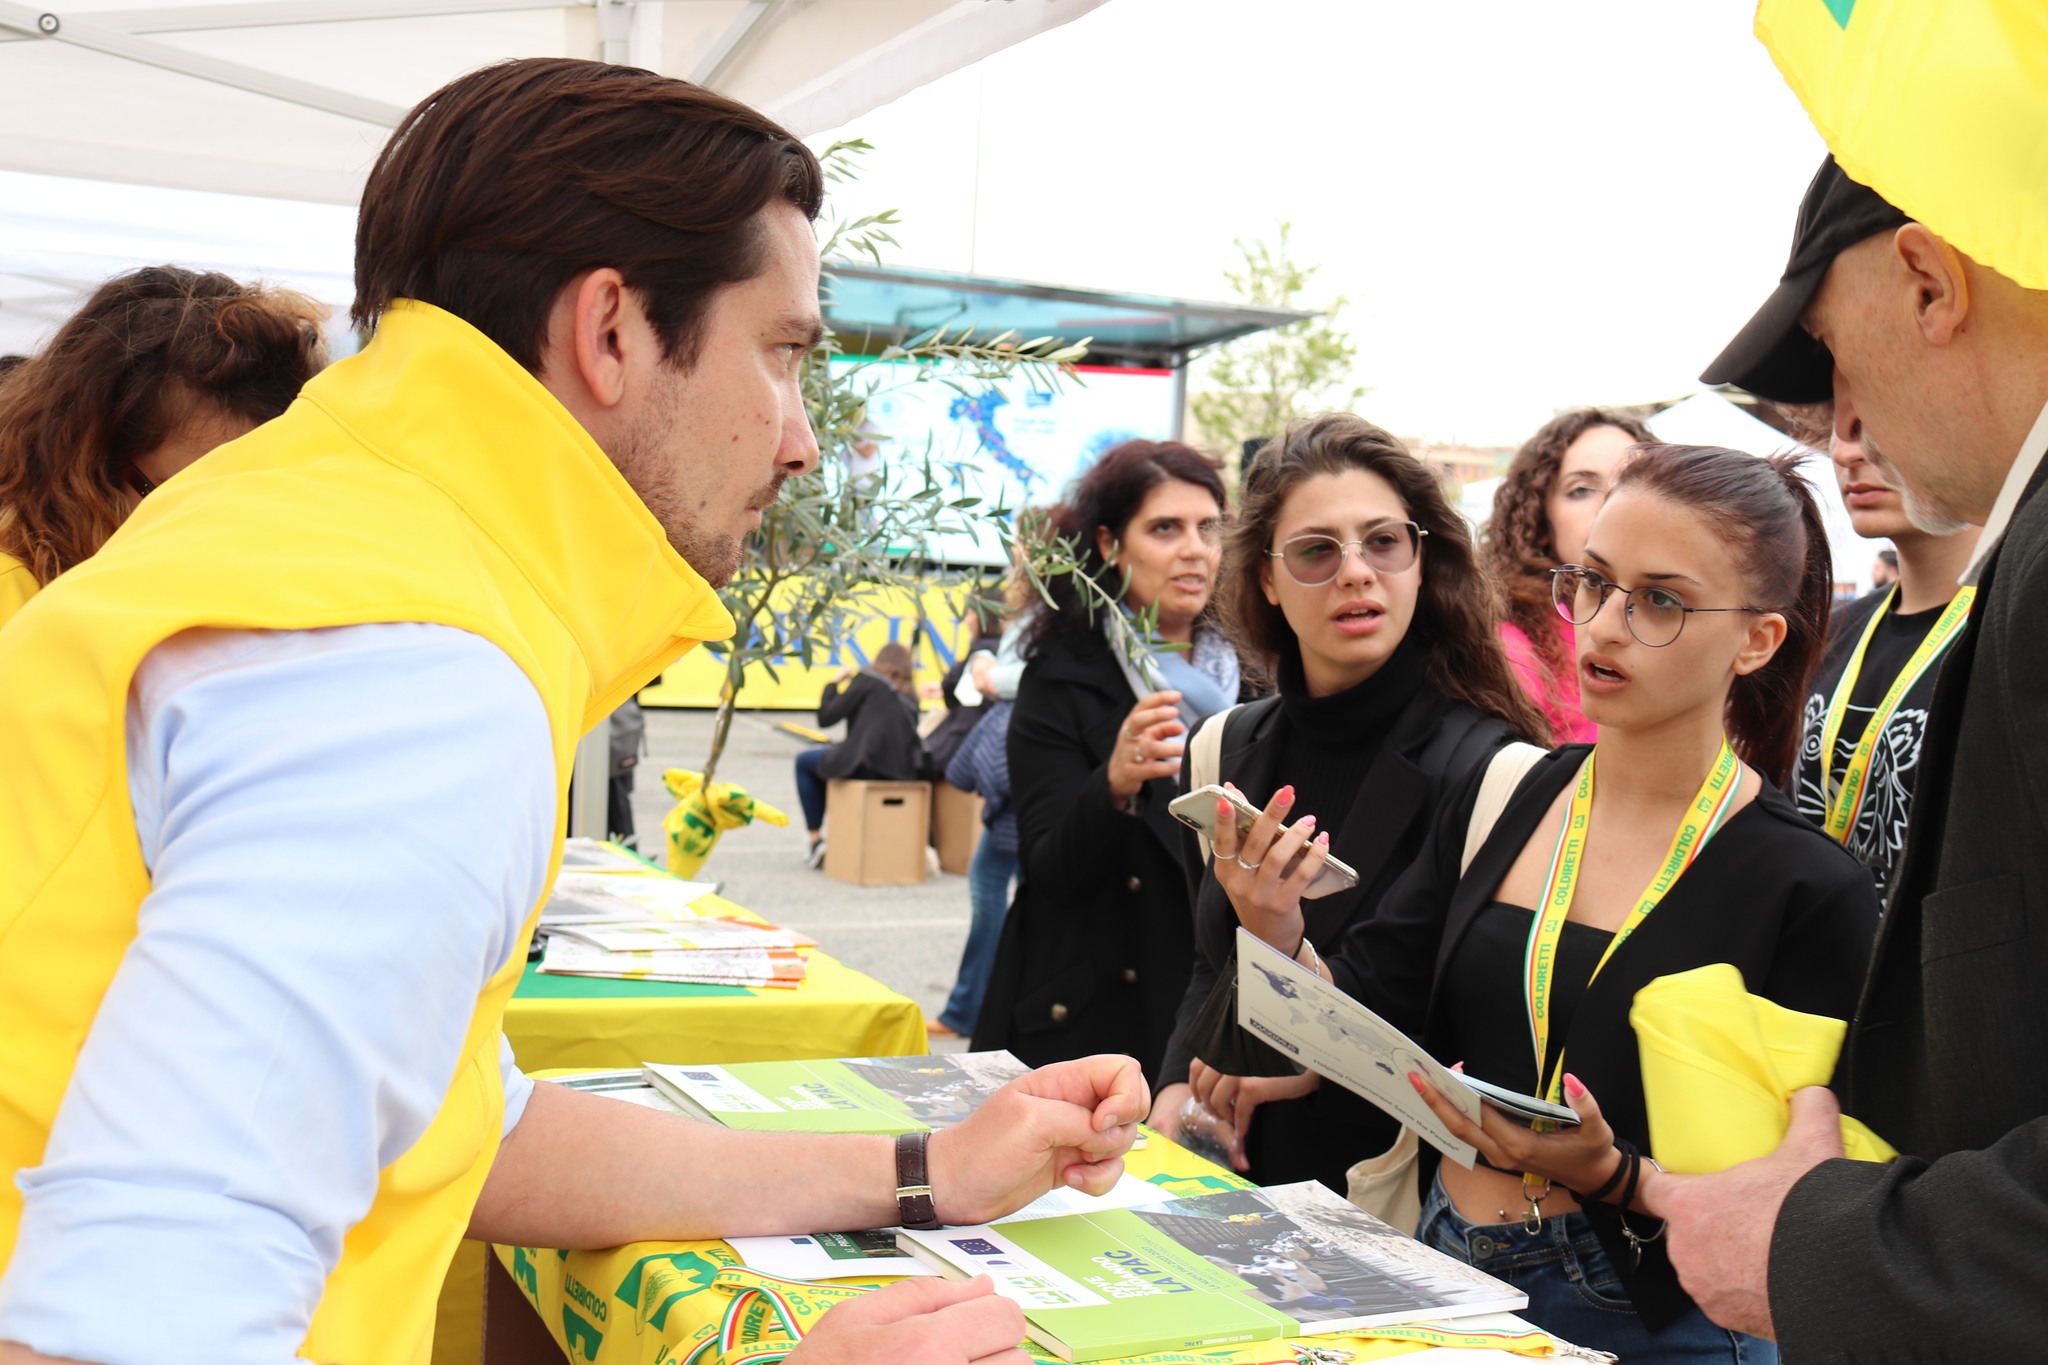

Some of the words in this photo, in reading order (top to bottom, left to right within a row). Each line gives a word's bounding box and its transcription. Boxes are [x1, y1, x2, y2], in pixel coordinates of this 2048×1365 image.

[1927, 594, 1971, 648] COLDIRETTI
[1869, 677, 1906, 734] COLDIRETTI
[1835, 768, 1860, 830] COLDIRETTI
[1554, 838, 1580, 906] COLDIRETTI
[1653, 824, 1697, 893] COLDIRETTI
[1536, 943, 1552, 1019] COLDIRETTI
[1083, 1275, 1133, 1298] DOVE
[1091, 1256, 1168, 1295] ANDANDO
[1104, 1250, 1162, 1275] PAC
[1152, 1277, 1194, 1293] LA
[564, 1273, 607, 1322] COLDIRETTI
[1114, 1281, 1149, 1297] STA
[1119, 1354, 1235, 1364] COLDIRETTI
